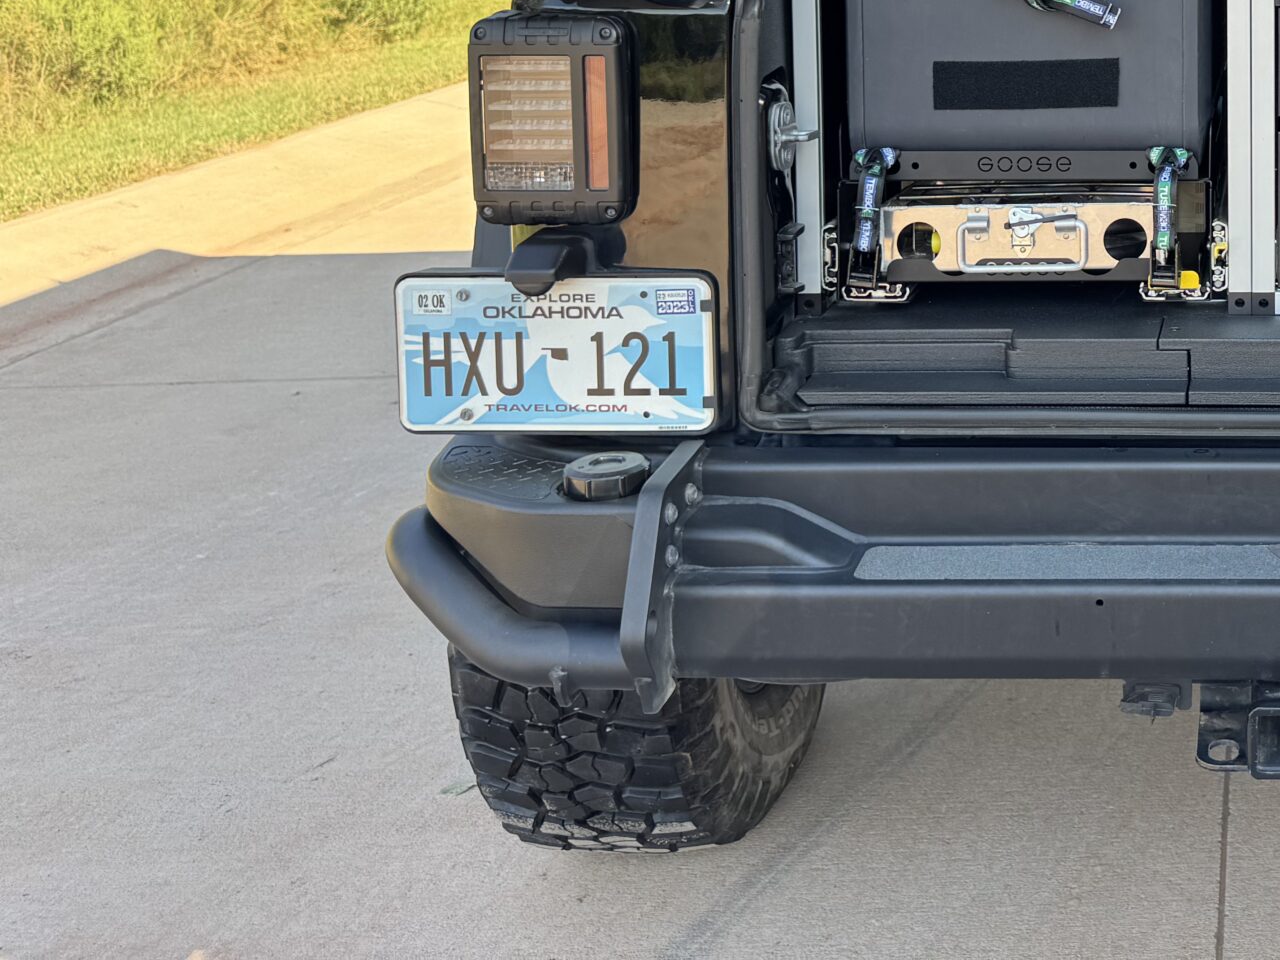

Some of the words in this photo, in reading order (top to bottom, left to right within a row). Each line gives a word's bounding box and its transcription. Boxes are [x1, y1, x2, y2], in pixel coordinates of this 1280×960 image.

[418, 294, 429, 308] 02
[431, 294, 446, 308] OK
[511, 293, 596, 303] EXPLORE
[483, 305, 623, 320] OKLAHOMA
[421, 331, 525, 397] HXU
[586, 331, 688, 396] 121
[484, 404, 628, 413] TRAVELOK.COM
